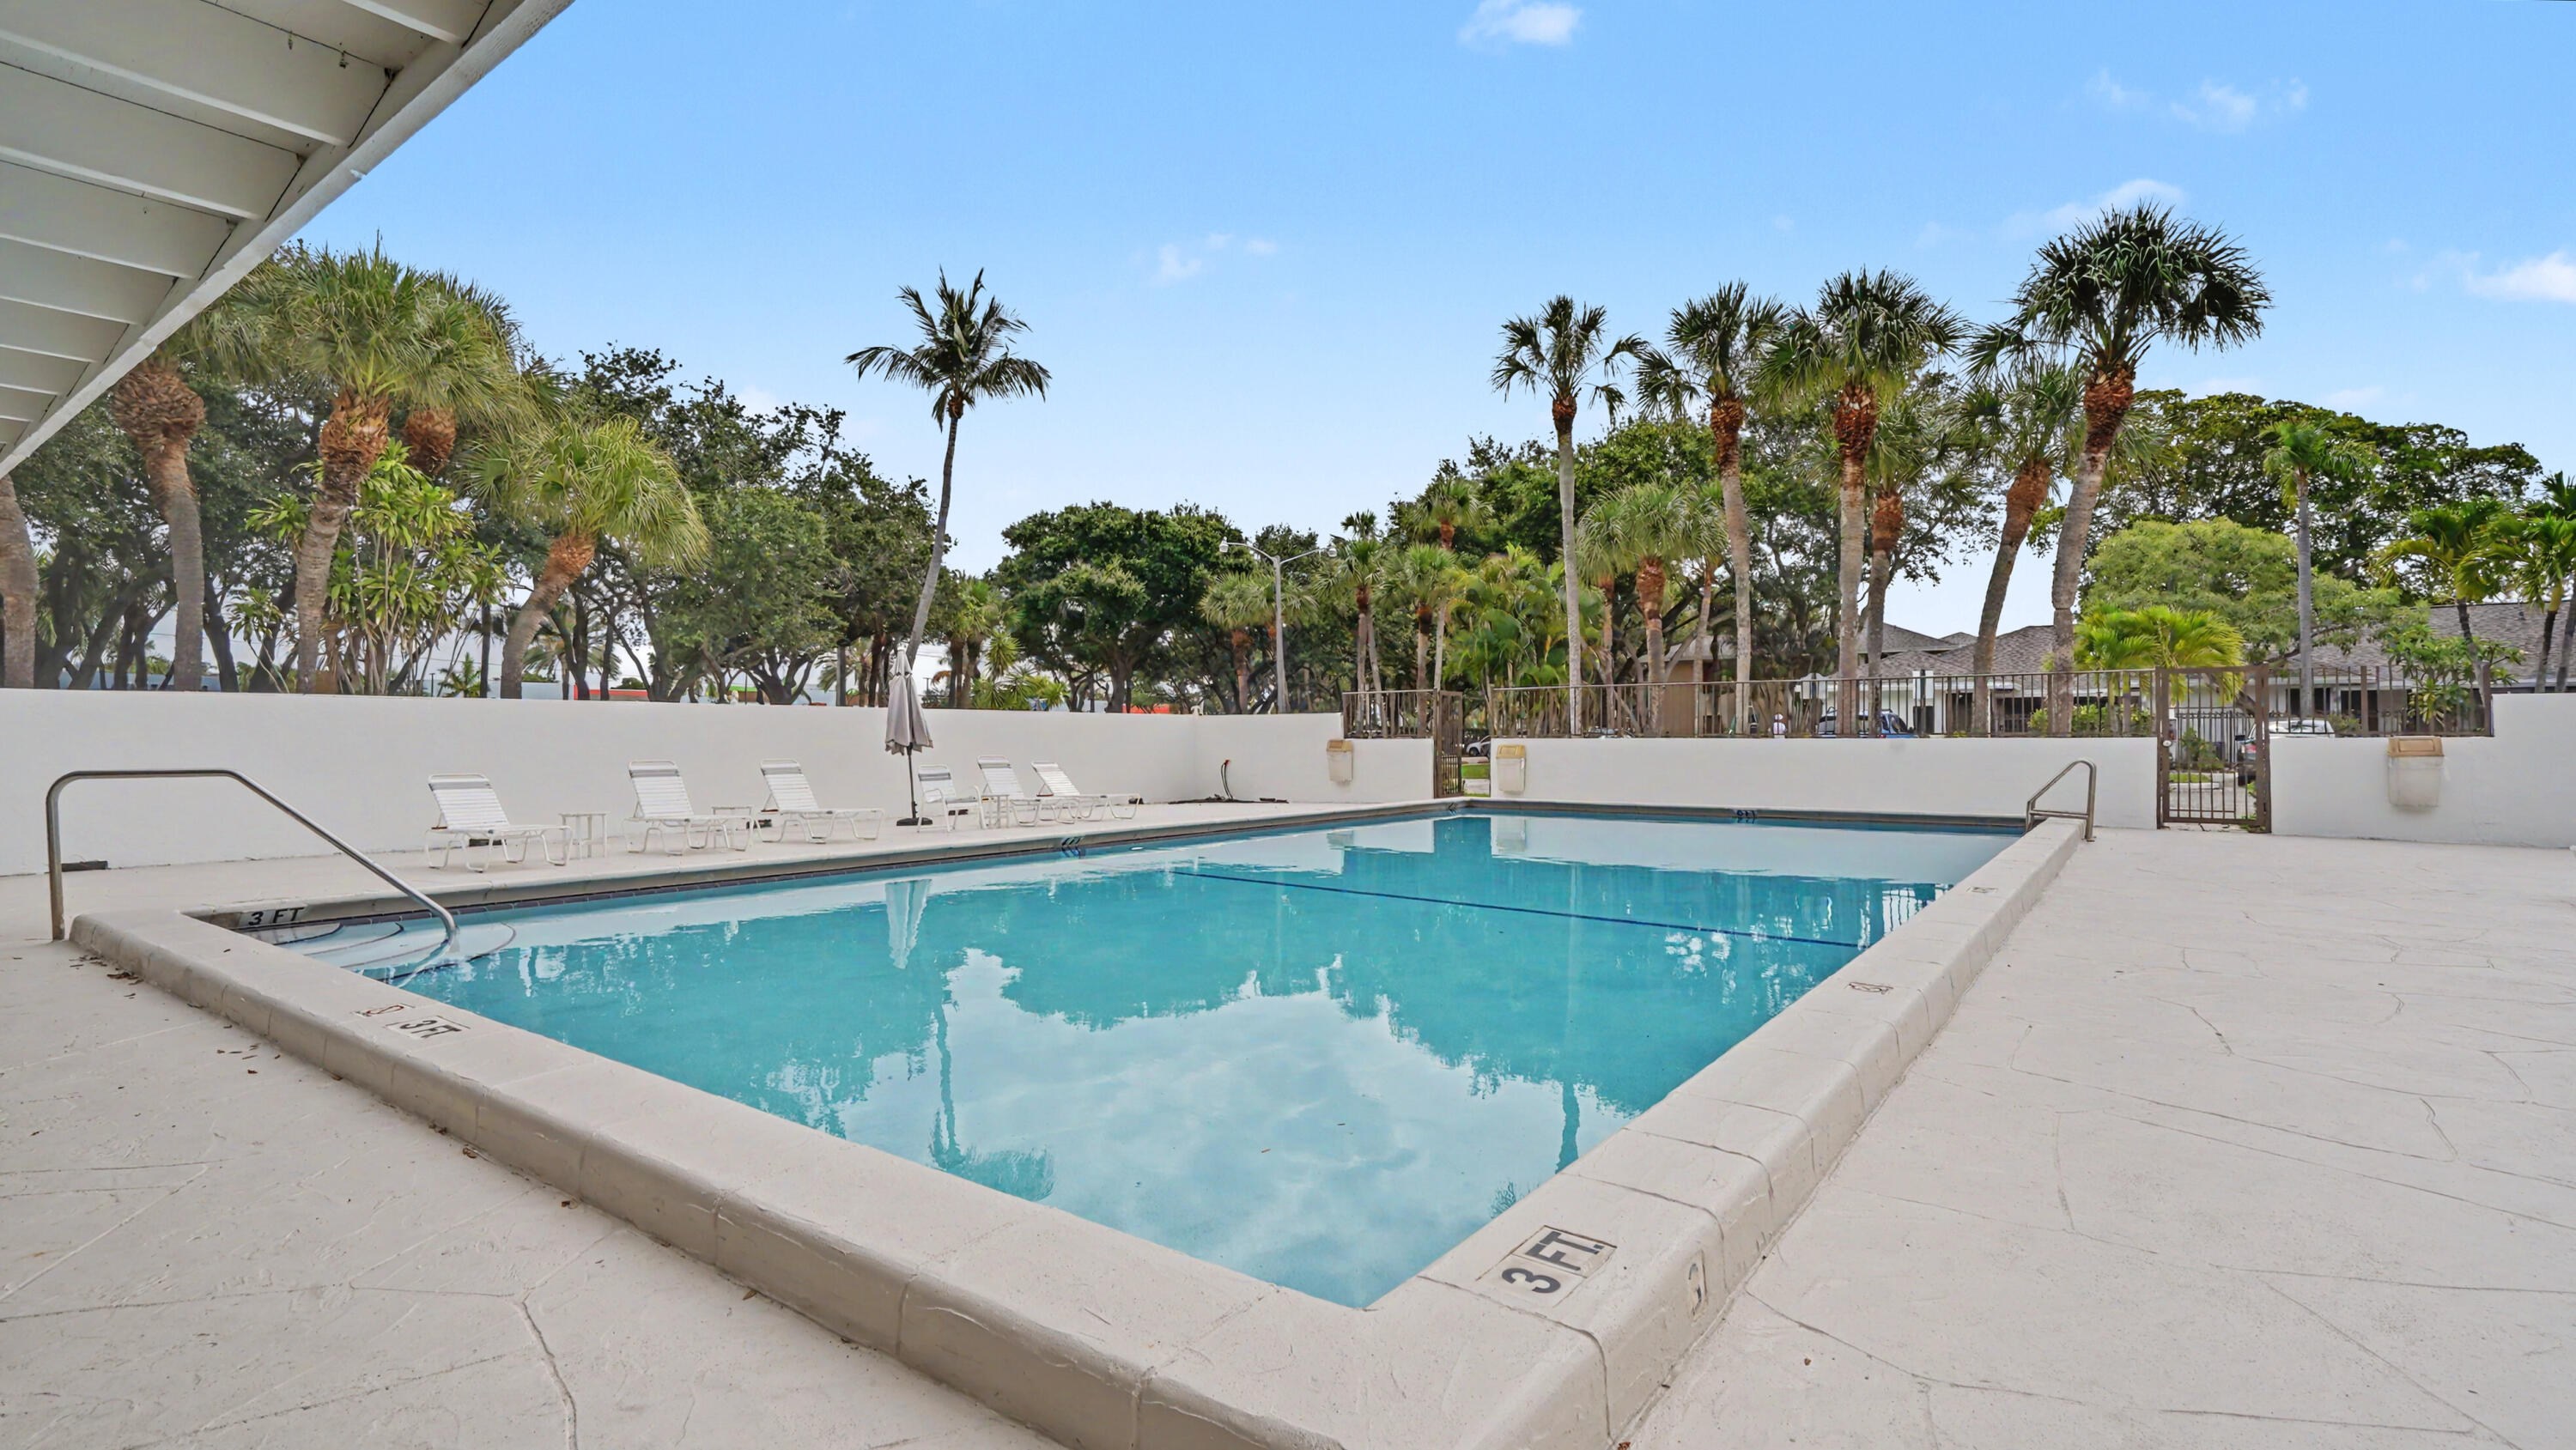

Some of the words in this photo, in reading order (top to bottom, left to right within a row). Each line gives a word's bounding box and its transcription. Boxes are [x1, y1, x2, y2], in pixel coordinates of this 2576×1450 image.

[248, 911, 264, 926] 3
[272, 907, 305, 924] FT
[399, 1020, 438, 1029] 3
[410, 1024, 463, 1039] FT
[1501, 1267, 1561, 1294] 3
